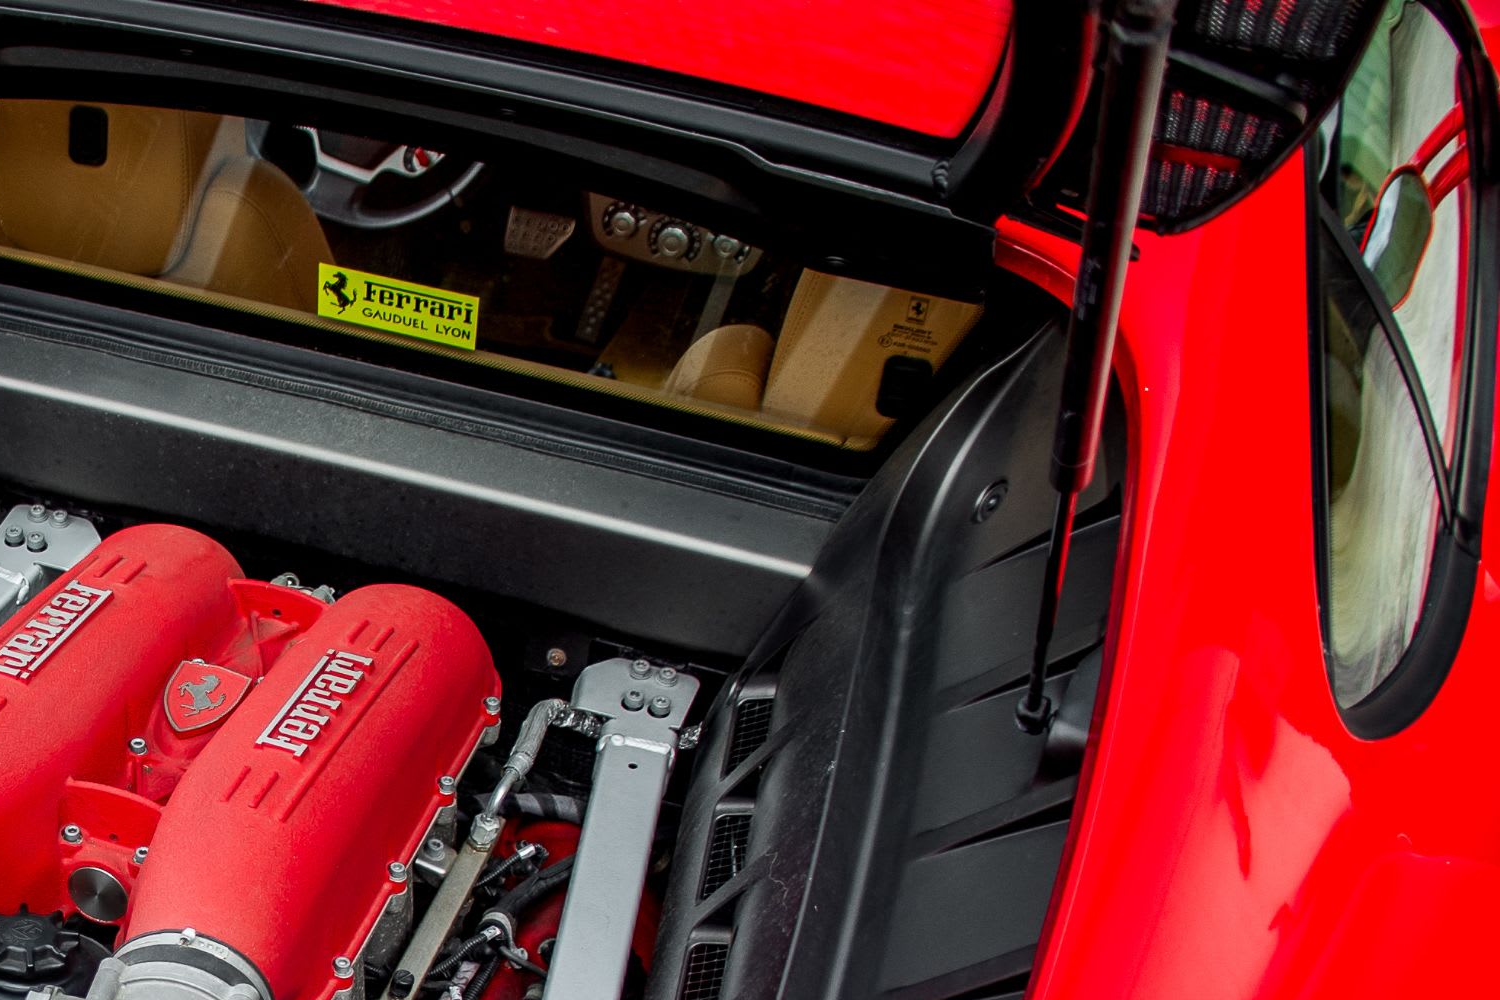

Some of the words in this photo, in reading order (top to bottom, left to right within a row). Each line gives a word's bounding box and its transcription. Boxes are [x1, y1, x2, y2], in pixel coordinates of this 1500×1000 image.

[361, 307, 429, 331] GAUDUEL
[435, 323, 471, 341] LYON
[362, 280, 474, 325] Ferrari
[255, 648, 376, 757] Ferrari
